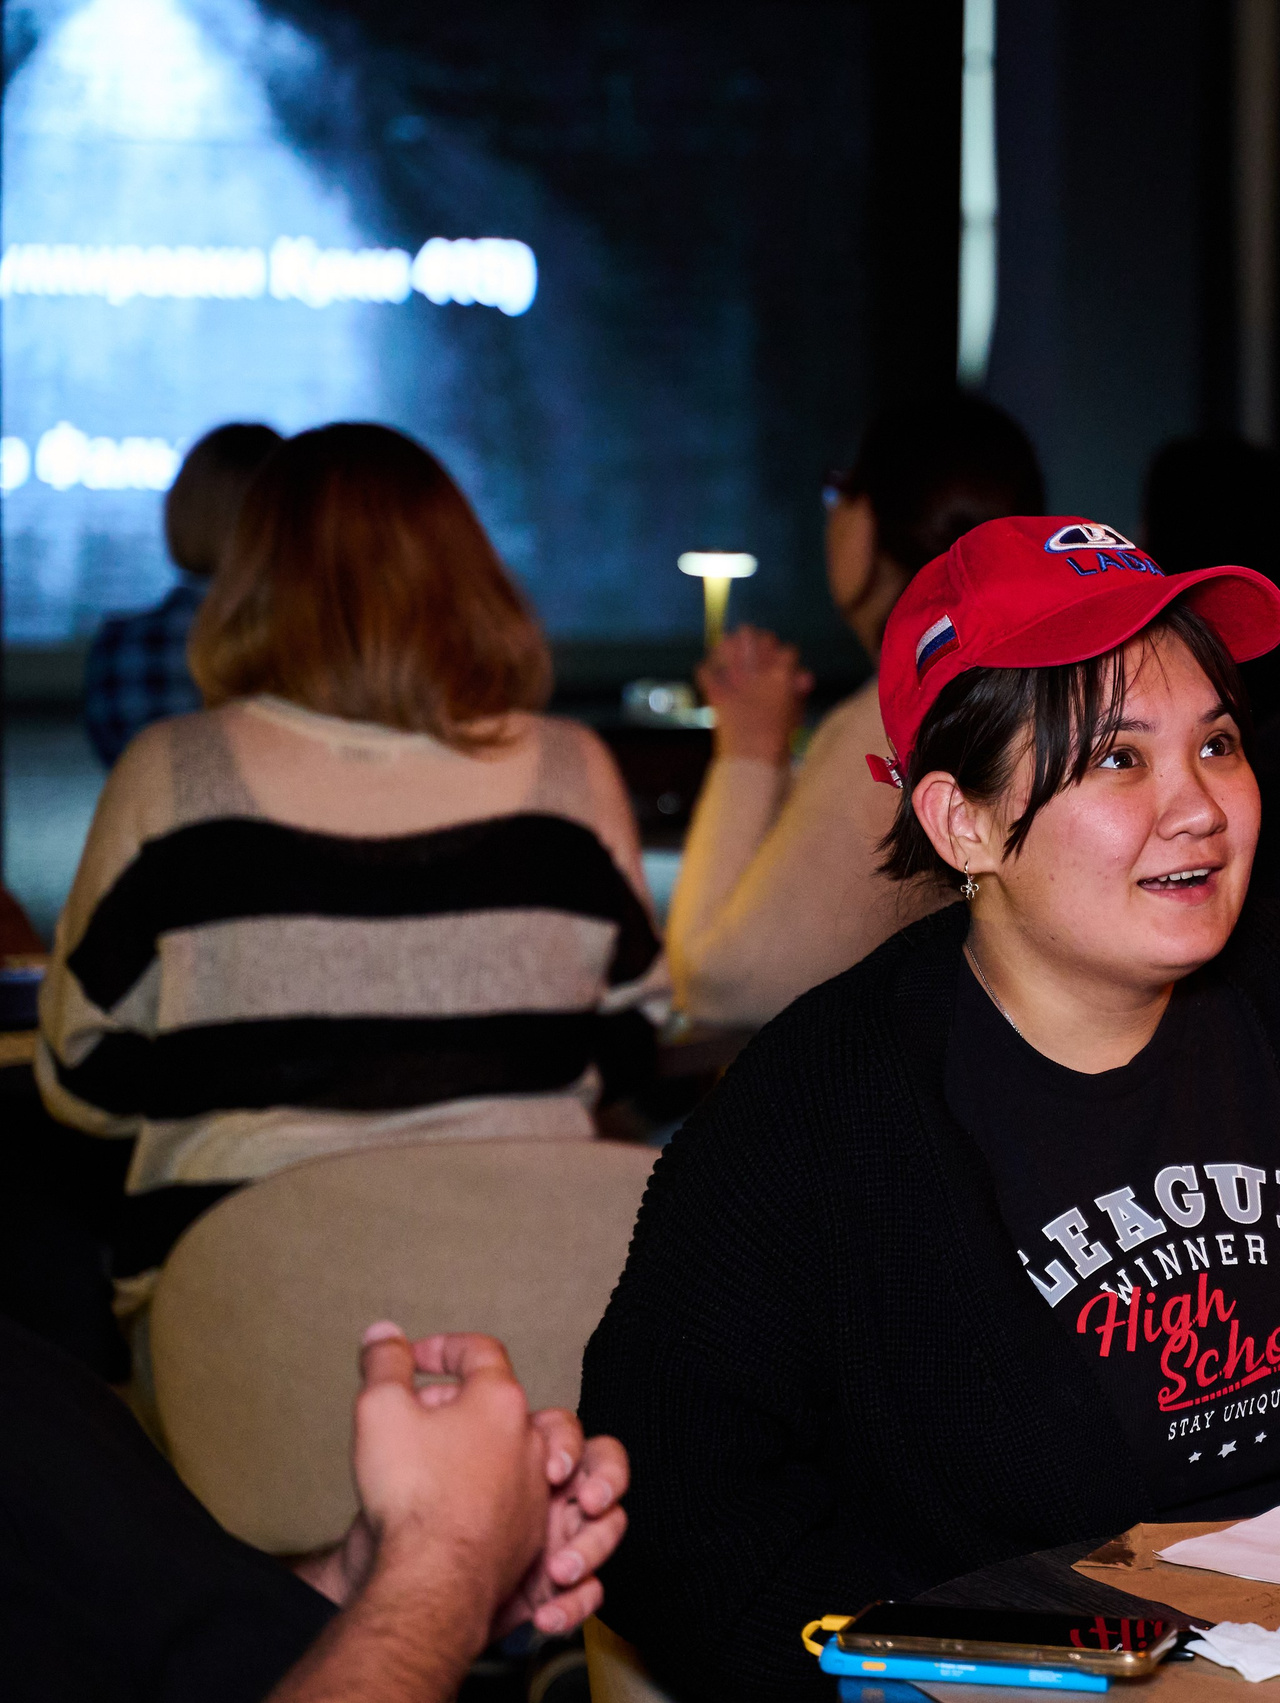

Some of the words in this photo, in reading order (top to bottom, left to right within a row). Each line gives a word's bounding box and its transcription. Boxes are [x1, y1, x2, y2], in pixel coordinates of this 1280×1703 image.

[1066, 551, 1166, 577] LADA
[1100, 1234, 1268, 1305] WINNER
[1077, 1272, 1237, 1357] High
[1168, 1410, 1215, 1441] STAY
